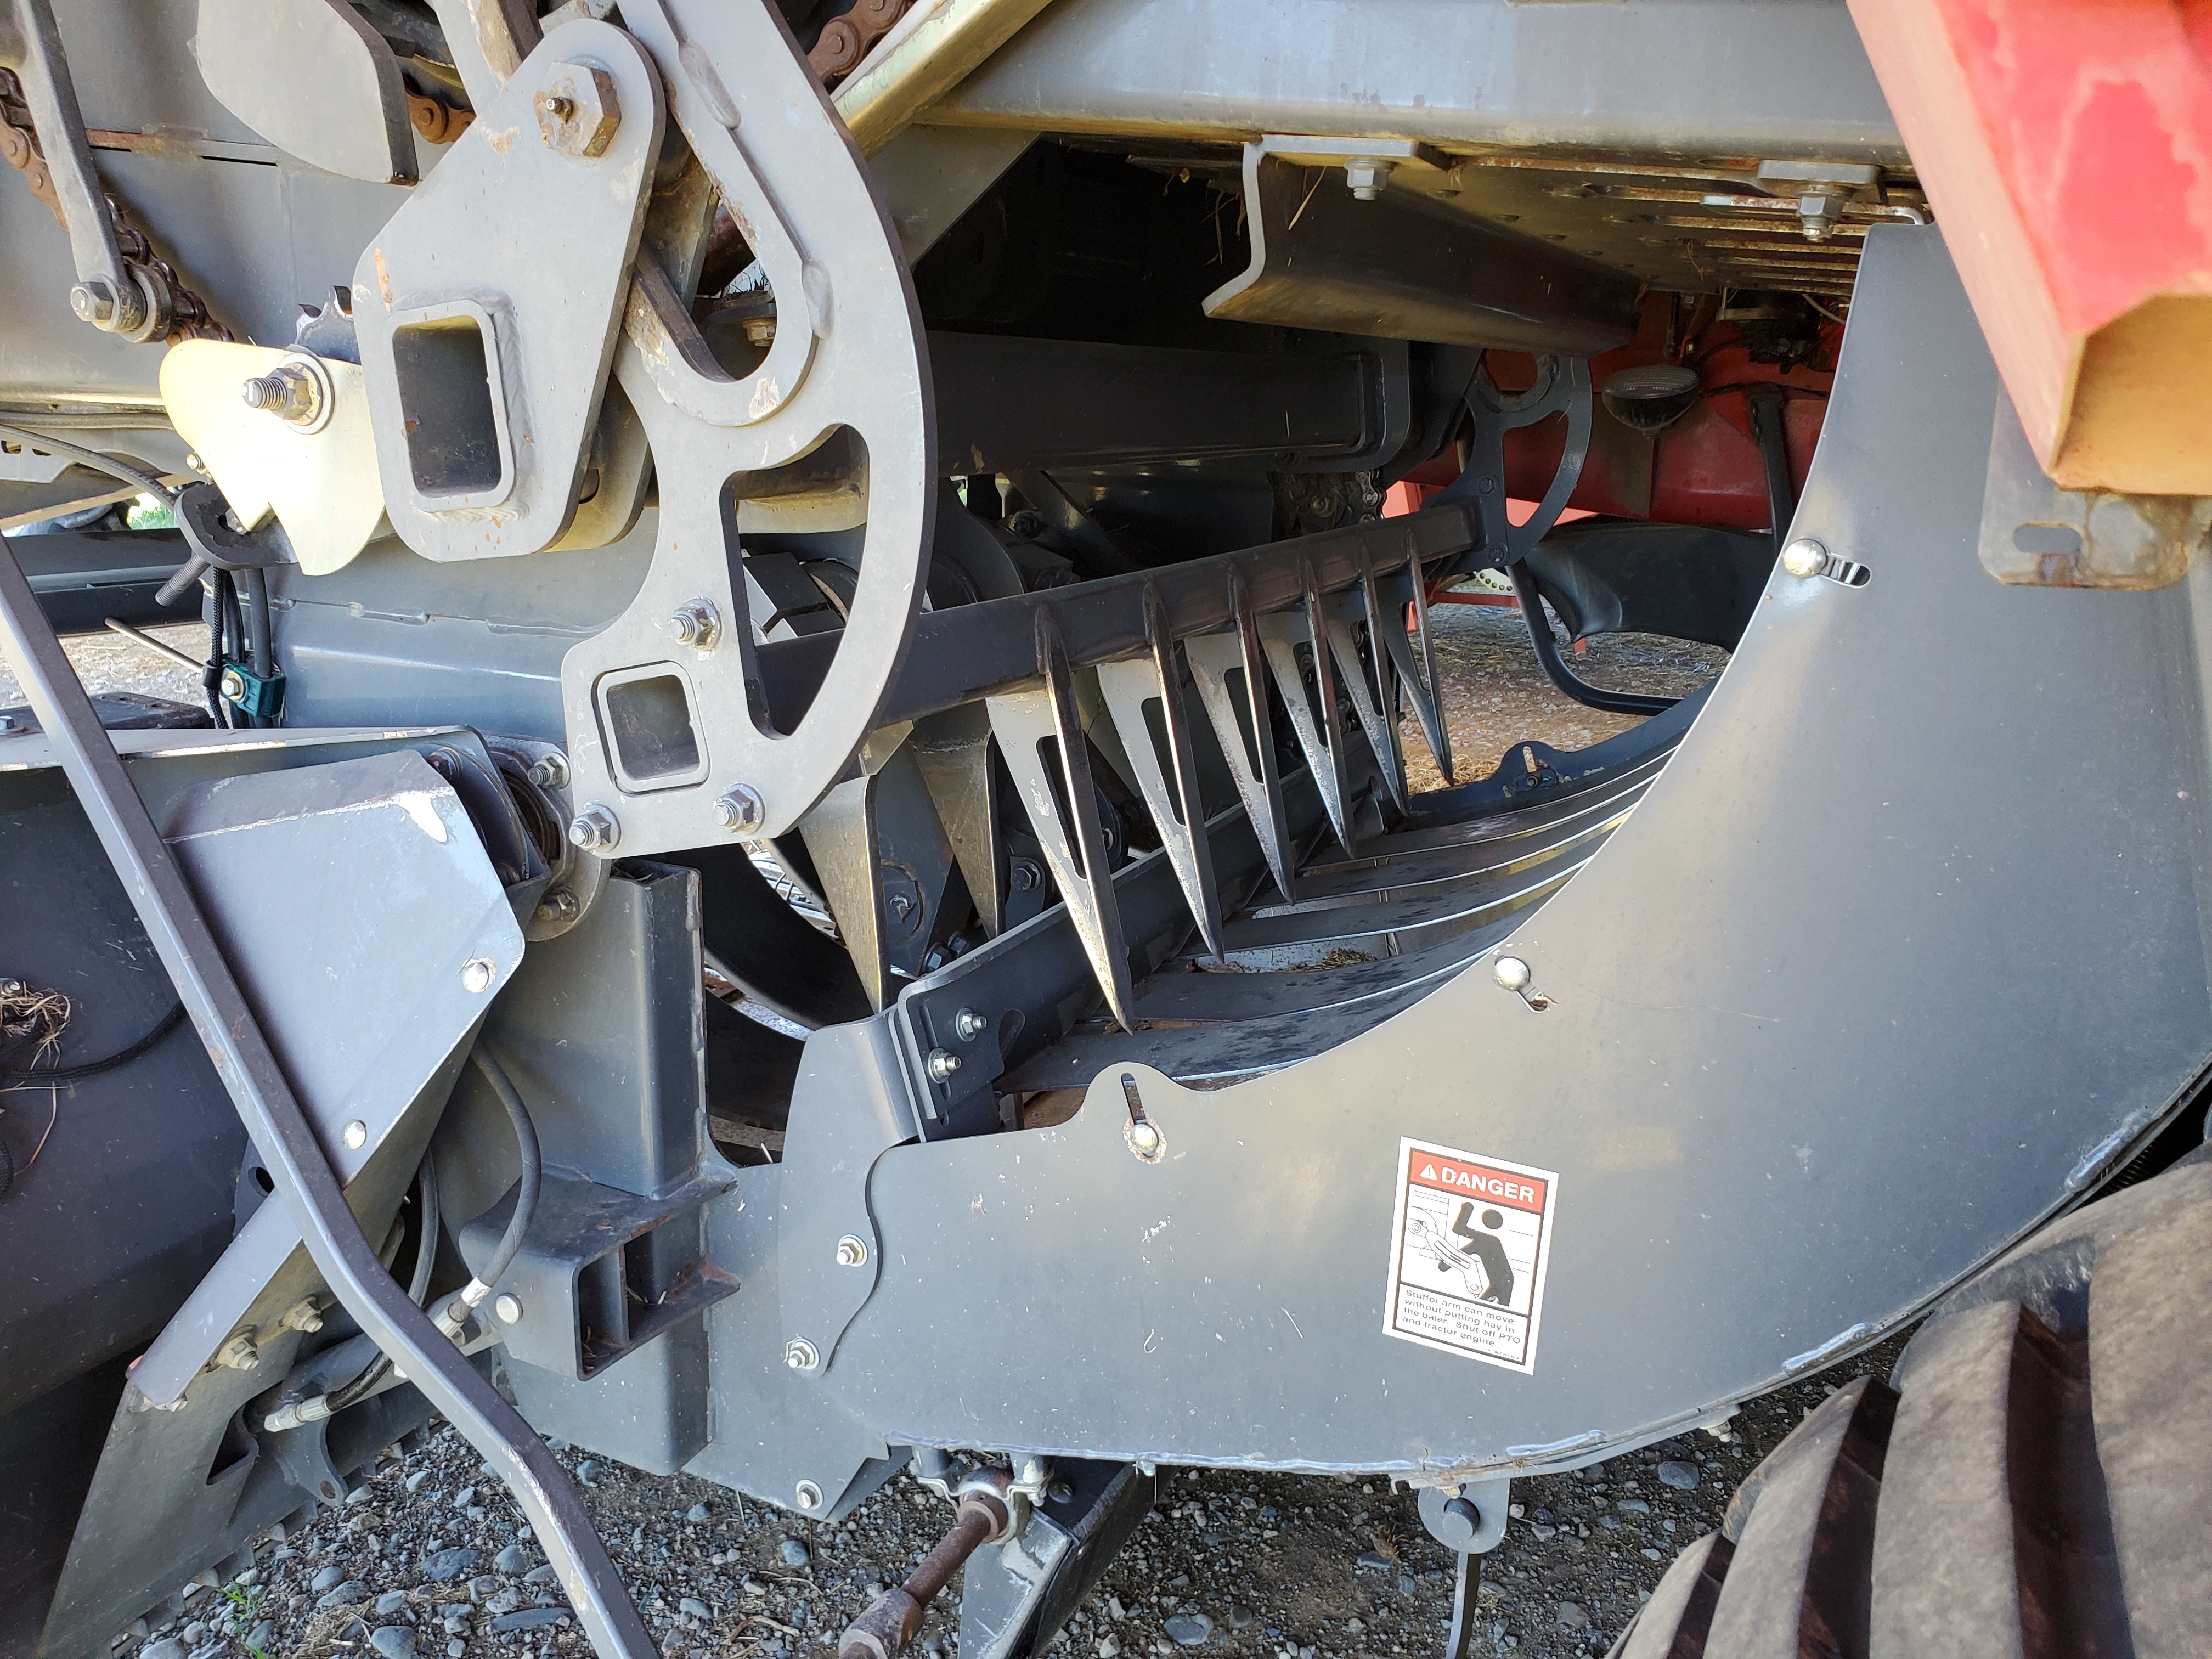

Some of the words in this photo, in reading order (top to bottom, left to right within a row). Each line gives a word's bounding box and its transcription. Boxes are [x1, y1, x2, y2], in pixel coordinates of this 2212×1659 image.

[1441, 1166, 1534, 1203] DANGER
[1404, 1299, 1441, 1313] without
[1444, 1310, 1480, 1325] putting
[1483, 1320, 1502, 1331] hay
[1406, 1289, 1439, 1303] Stuffer
[1442, 1301, 1461, 1310] arm
[1464, 1307, 1482, 1316] can
[1486, 1312, 1514, 1324] move
[1403, 1317, 1421, 1325] and
[1424, 1322, 1457, 1335] tractor
[1460, 1333, 1497, 1347] engine.
[1404, 1307, 1419, 1316] the
[1422, 1312, 1449, 1325] baler.
[1455, 1321, 1479, 1333] Shut
[1499, 1333, 1520, 1344] PTO
